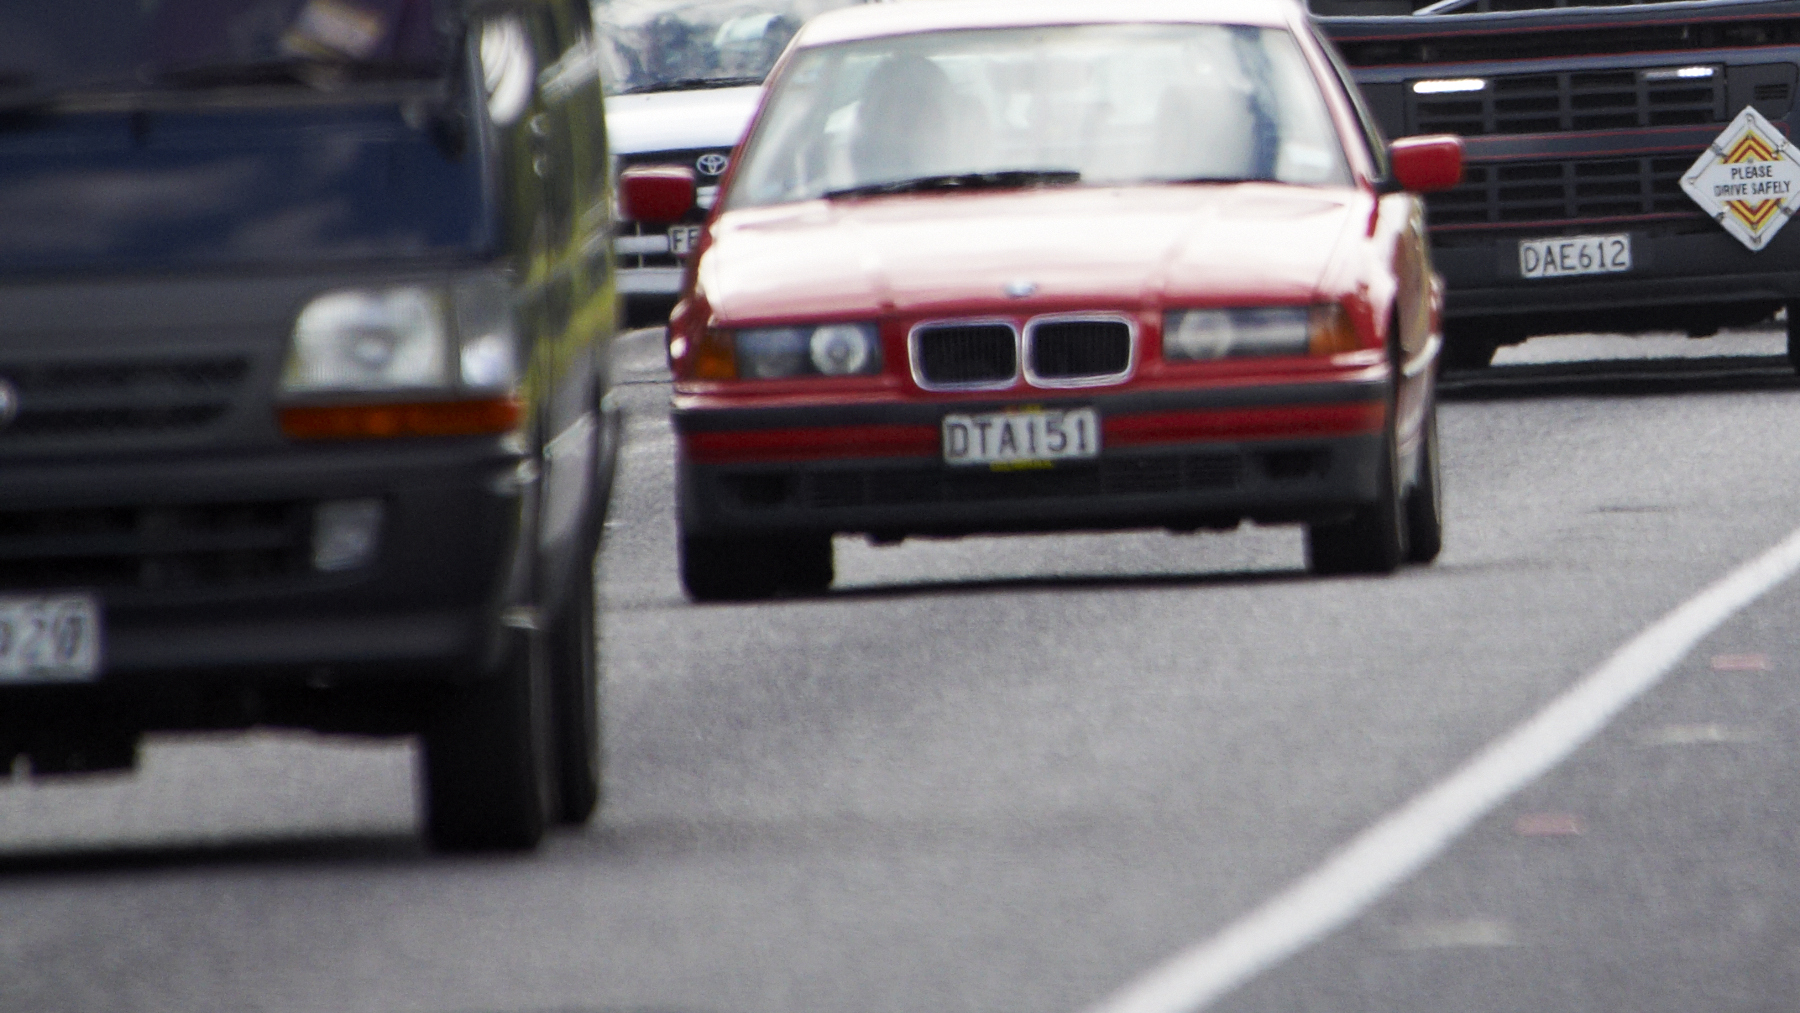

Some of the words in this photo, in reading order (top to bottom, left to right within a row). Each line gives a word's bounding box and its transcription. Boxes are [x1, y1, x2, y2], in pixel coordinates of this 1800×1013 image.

[1731, 165, 1773, 180] PLEASE
[1714, 183, 1748, 197] DRIVE
[1751, 180, 1791, 195] SAFELY
[1523, 239, 1627, 274] DAE612
[947, 417, 1087, 457] DTA151
